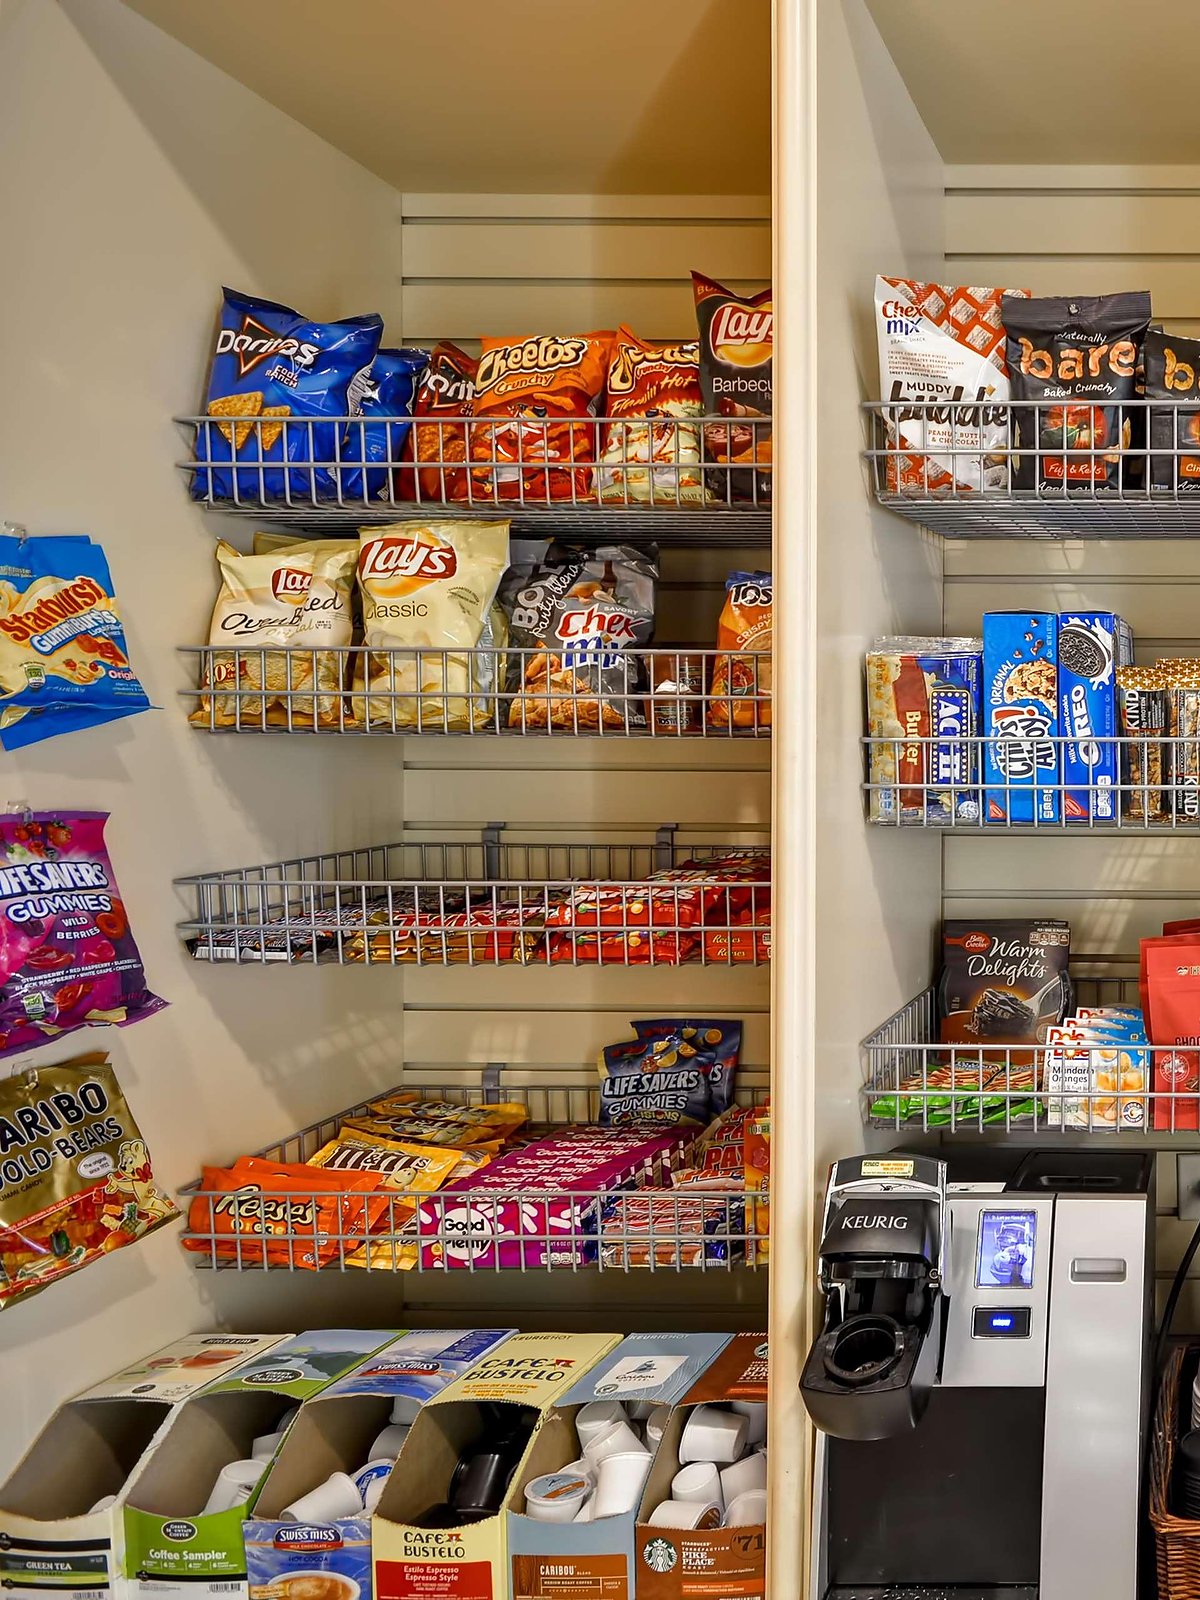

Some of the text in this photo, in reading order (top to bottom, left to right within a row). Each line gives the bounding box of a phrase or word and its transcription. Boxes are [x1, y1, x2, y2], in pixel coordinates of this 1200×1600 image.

[882, 300, 924, 318] Chex
[887, 318, 922, 335] mix
[216, 330, 319, 366] Doritos
[475, 336, 586, 394] Cheetos
[1018, 336, 1136, 381] bare
[265, 369, 298, 388] RANCH
[275, 364, 299, 383] COOL
[660, 373, 697, 390] Hot
[495, 373, 554, 394] Crunchy
[713, 377, 772, 393] Barbecu
[906, 382, 952, 394] MUDDY
[1043, 383, 1117, 398] Baked Crunchy
[361, 541, 452, 580] Lay's
[1, 577, 105, 642] Starburst
[366, 600, 428, 619] Classic
[603, 606, 639, 616] SAVORY
[557, 606, 644, 638] Chex
[990, 660, 1015, 705] ORIGINAL
[1126, 689, 1140, 730] KIND
[1071, 684, 1103, 765] OREO
[8, 895, 112, 922] GUMMIES
[62, 916, 88, 926] WILD
[57, 927, 100, 940] BERRIES
[989, 937, 1047, 958] Warm
[967, 954, 1047, 986] Delights
[1190, 967, 1200, 975] THE
[609, 1095, 688, 1115] GUMMIES
[0, 1083, 107, 1151] ARIBO
[214, 1184, 322, 1224] Reese's
[841, 1216, 908, 1230] KEURIG
[464, 1370, 565, 1381] BUSTELO
[149, 1549, 227, 1562] Coffee Sampler
[404, 1545, 465, 1558] BUSTELO
[682, 1551, 707, 1559] PIKE
[26, 1561, 72, 1571] GREEN TEA
[403, 1565, 459, 1576] Estilo Espresso
[540, 1565, 574, 1575] CARIBOU
[682, 1558, 714, 1566] PLACE
[405, 1573, 459, 1582] Espresso Style
